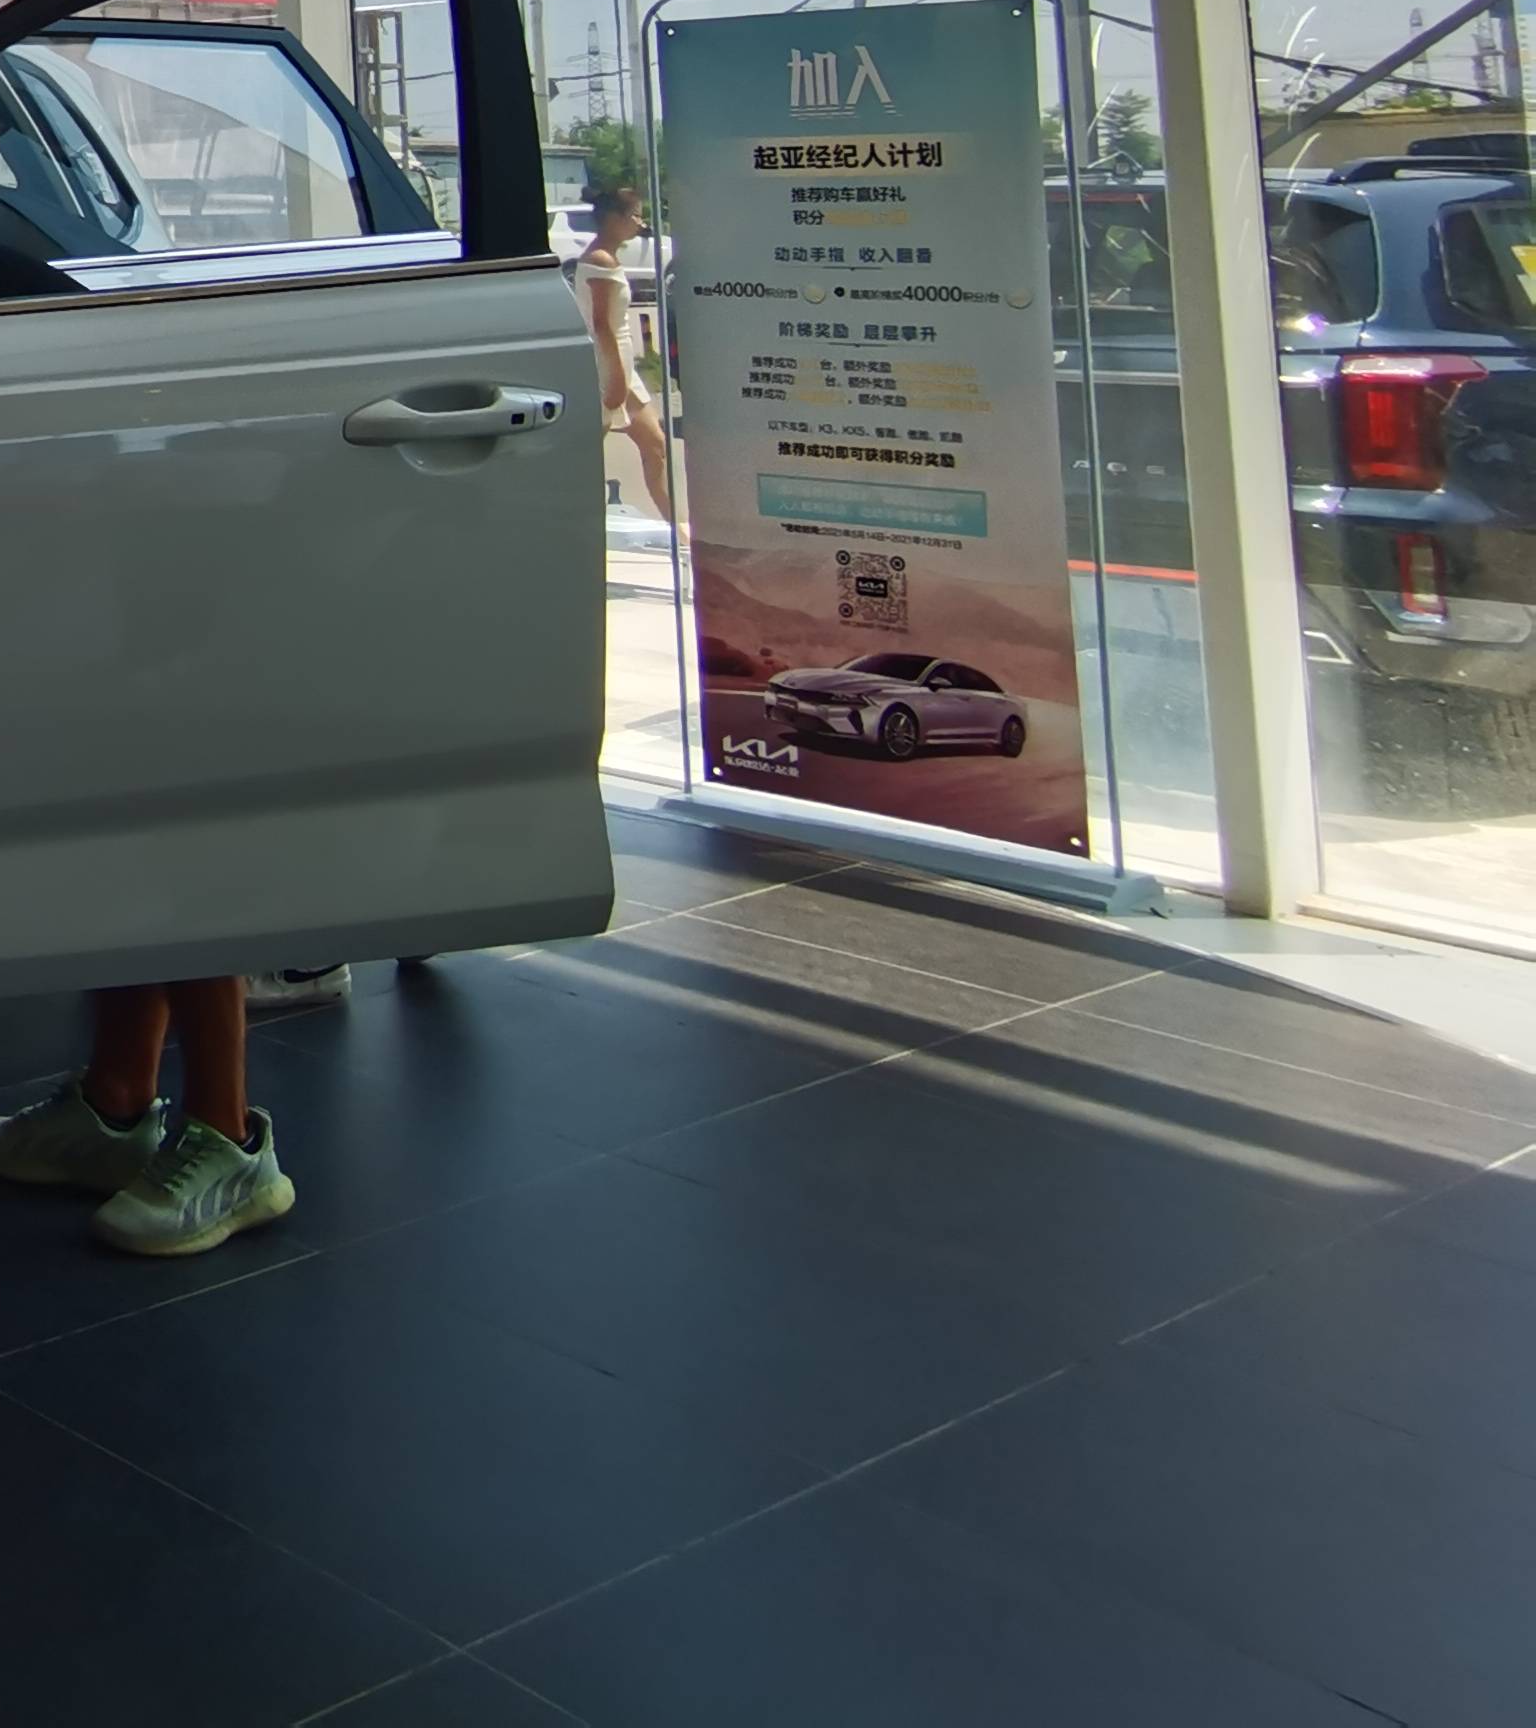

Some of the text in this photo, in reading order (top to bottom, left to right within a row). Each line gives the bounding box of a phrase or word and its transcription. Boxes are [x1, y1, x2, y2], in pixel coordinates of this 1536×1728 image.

[786, 45, 903, 119] 加入
[753, 142, 944, 170] 起亚经纪人计划
[791, 186, 906, 203] 推荐购车赢好礼
[722, 735, 798, 763] KIA
